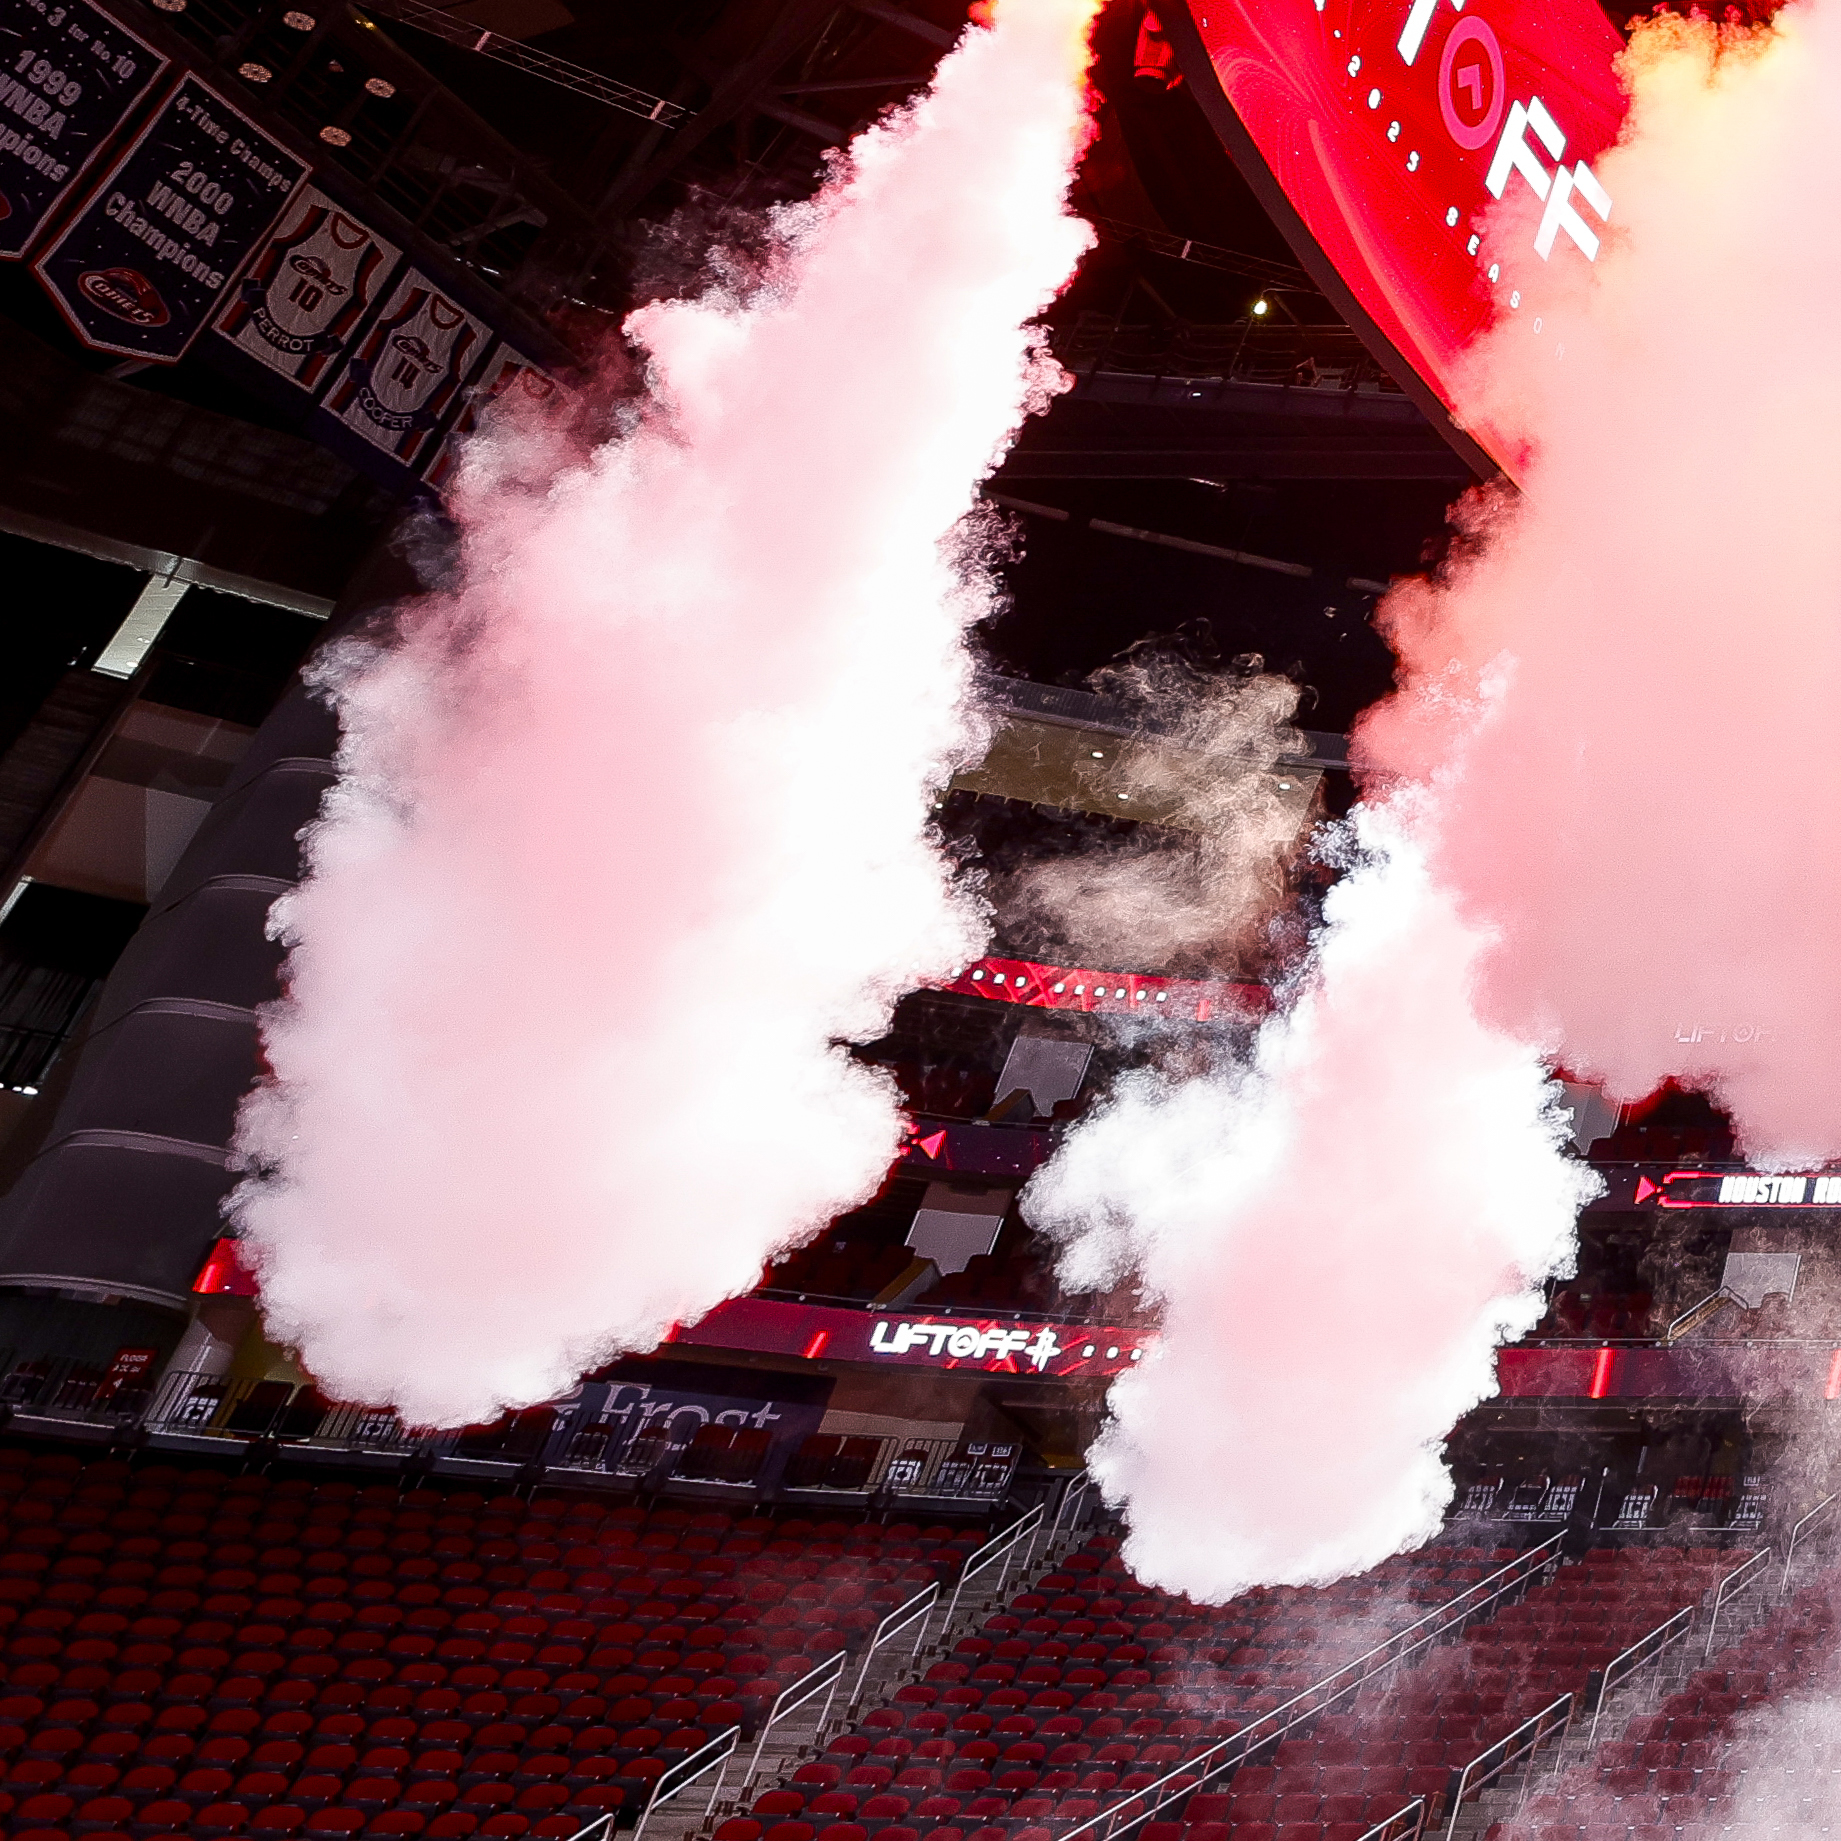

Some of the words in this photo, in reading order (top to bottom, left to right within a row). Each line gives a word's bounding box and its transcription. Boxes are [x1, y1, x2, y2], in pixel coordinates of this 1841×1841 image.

[47, 6, 67, 27] 3
[111, 54, 137, 79] 10
[14, 49, 82, 107] 1999
[175, 94, 230, 144] 4-Time
[229, 138, 292, 193] Champs
[170, 160, 234, 215] 2000
[147, 179, 220, 247] WNBA
[105, 191, 225, 289] Champions
[288, 277, 323, 312] 10
[252, 307, 315, 352] PERROT
[391, 357, 420, 390] 14
[358, 387, 413, 429] COOPER
[1718, 1176, 1807, 1204] HOUSTON
[870, 1321, 1030, 1359] LIFTOFF
